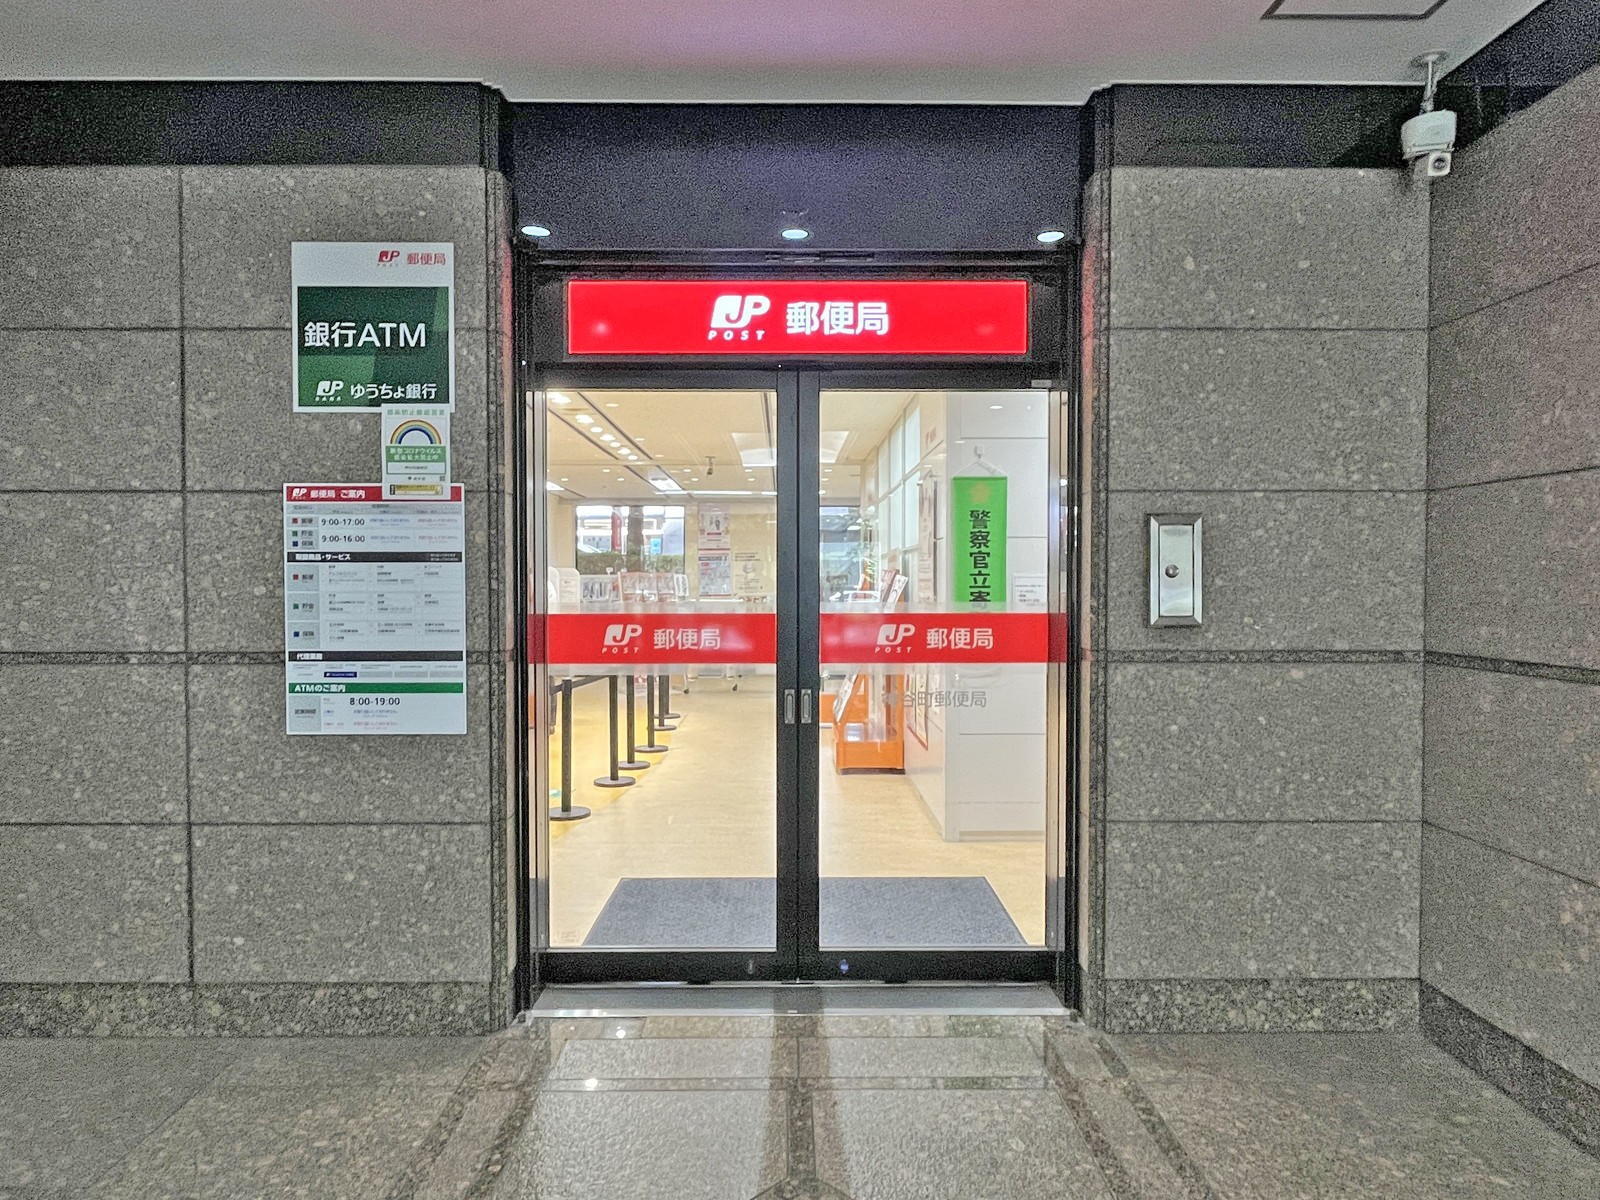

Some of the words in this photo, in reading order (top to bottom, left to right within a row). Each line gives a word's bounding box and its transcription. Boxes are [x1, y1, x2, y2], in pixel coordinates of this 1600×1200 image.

[407, 252, 446, 265] 郵便局
[786, 301, 890, 336] 郵便局
[303, 321, 427, 348] 銀行ATM
[708, 329, 765, 341] POST
[350, 383, 438, 400] ゆうちょ銀行
[321, 518, 366, 526] 9:00-17:00
[321, 535, 366, 543] 9:00-16:00
[653, 628, 721, 650] 郵便局
[926, 627, 994, 650] 郵便局
[294, 684, 346, 693] ATMのご案内
[349, 697, 401, 706] 8:00-19:00
[882, 690, 987, 708] 谷町郵便局
